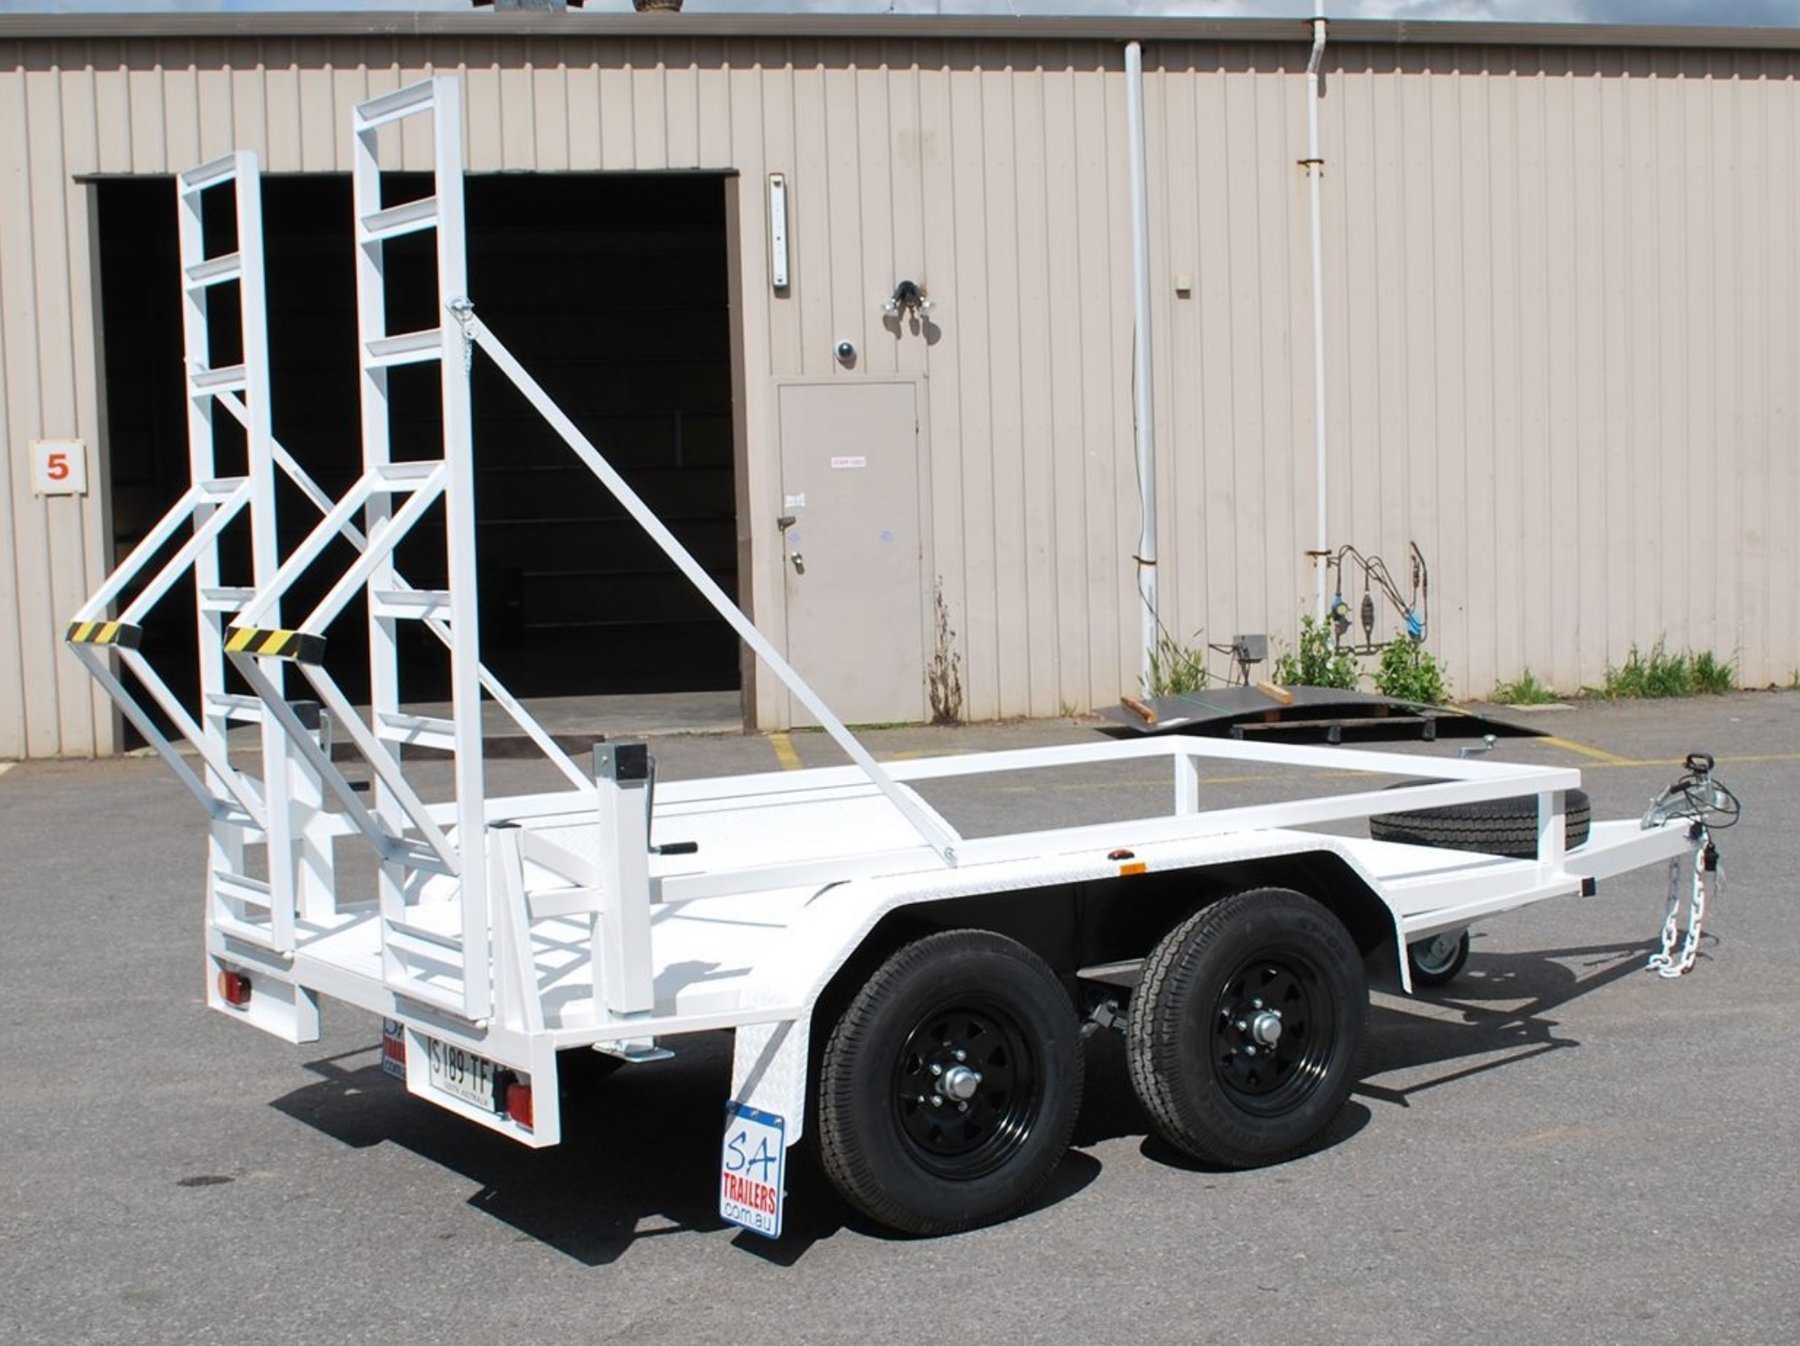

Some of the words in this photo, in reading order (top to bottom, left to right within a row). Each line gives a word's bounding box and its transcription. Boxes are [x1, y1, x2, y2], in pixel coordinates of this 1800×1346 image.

[48, 453, 69, 480] 5
[726, 1131, 776, 1182] SA
[724, 1172, 776, 1215] TRAILERS
